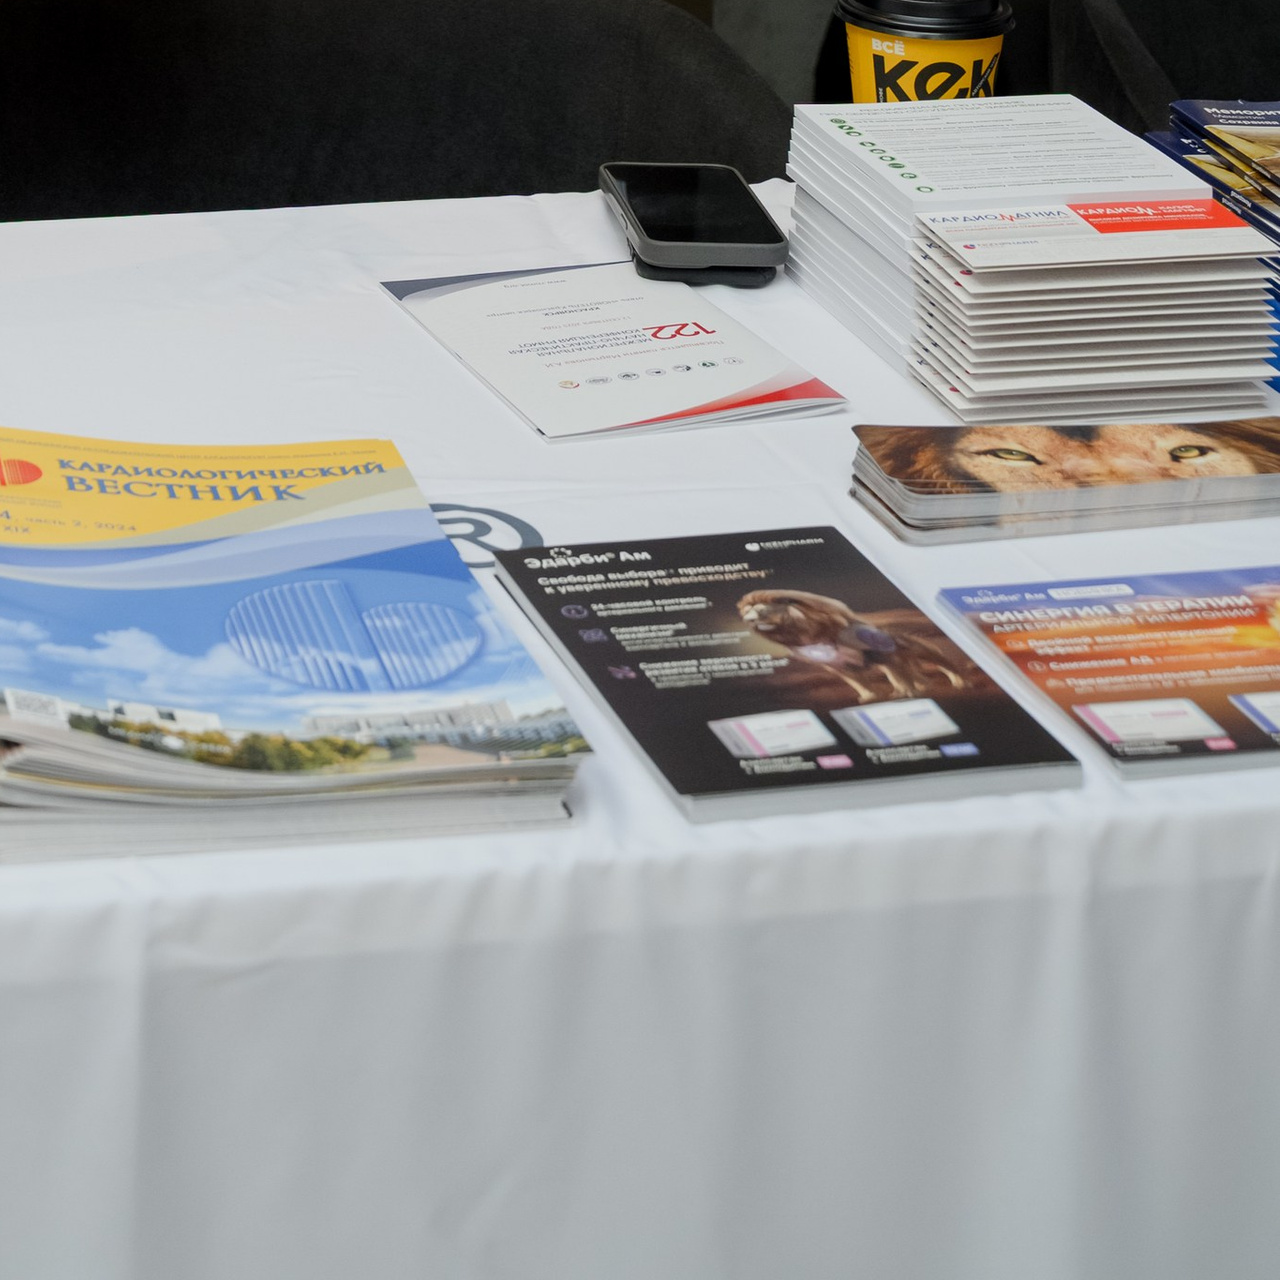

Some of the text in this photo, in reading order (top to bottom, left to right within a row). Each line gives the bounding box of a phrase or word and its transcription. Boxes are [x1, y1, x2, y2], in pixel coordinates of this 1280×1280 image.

[871, 36, 906, 57] ВСЁ
[928, 210, 1069, 224] КАРДИОМАГНИЛ
[642, 321, 717, 341] 122
[57, 458, 387, 481] КАРДИОЛОГИЧЕСКИЙ
[62, 474, 306, 502] ВЕСТНИК
[94, 520, 138, 532] 2024
[619, 550, 652, 562] Ам
[537, 573, 606, 587] Свобода
[677, 562, 750, 575] приводит
[556, 579, 651, 595] уверенному
[978, 594, 1254, 624] СИНЕРГИЯ В ТЕРАПИИ
[992, 616, 1135, 634] АРТЕРИАЛЬНОЙ
